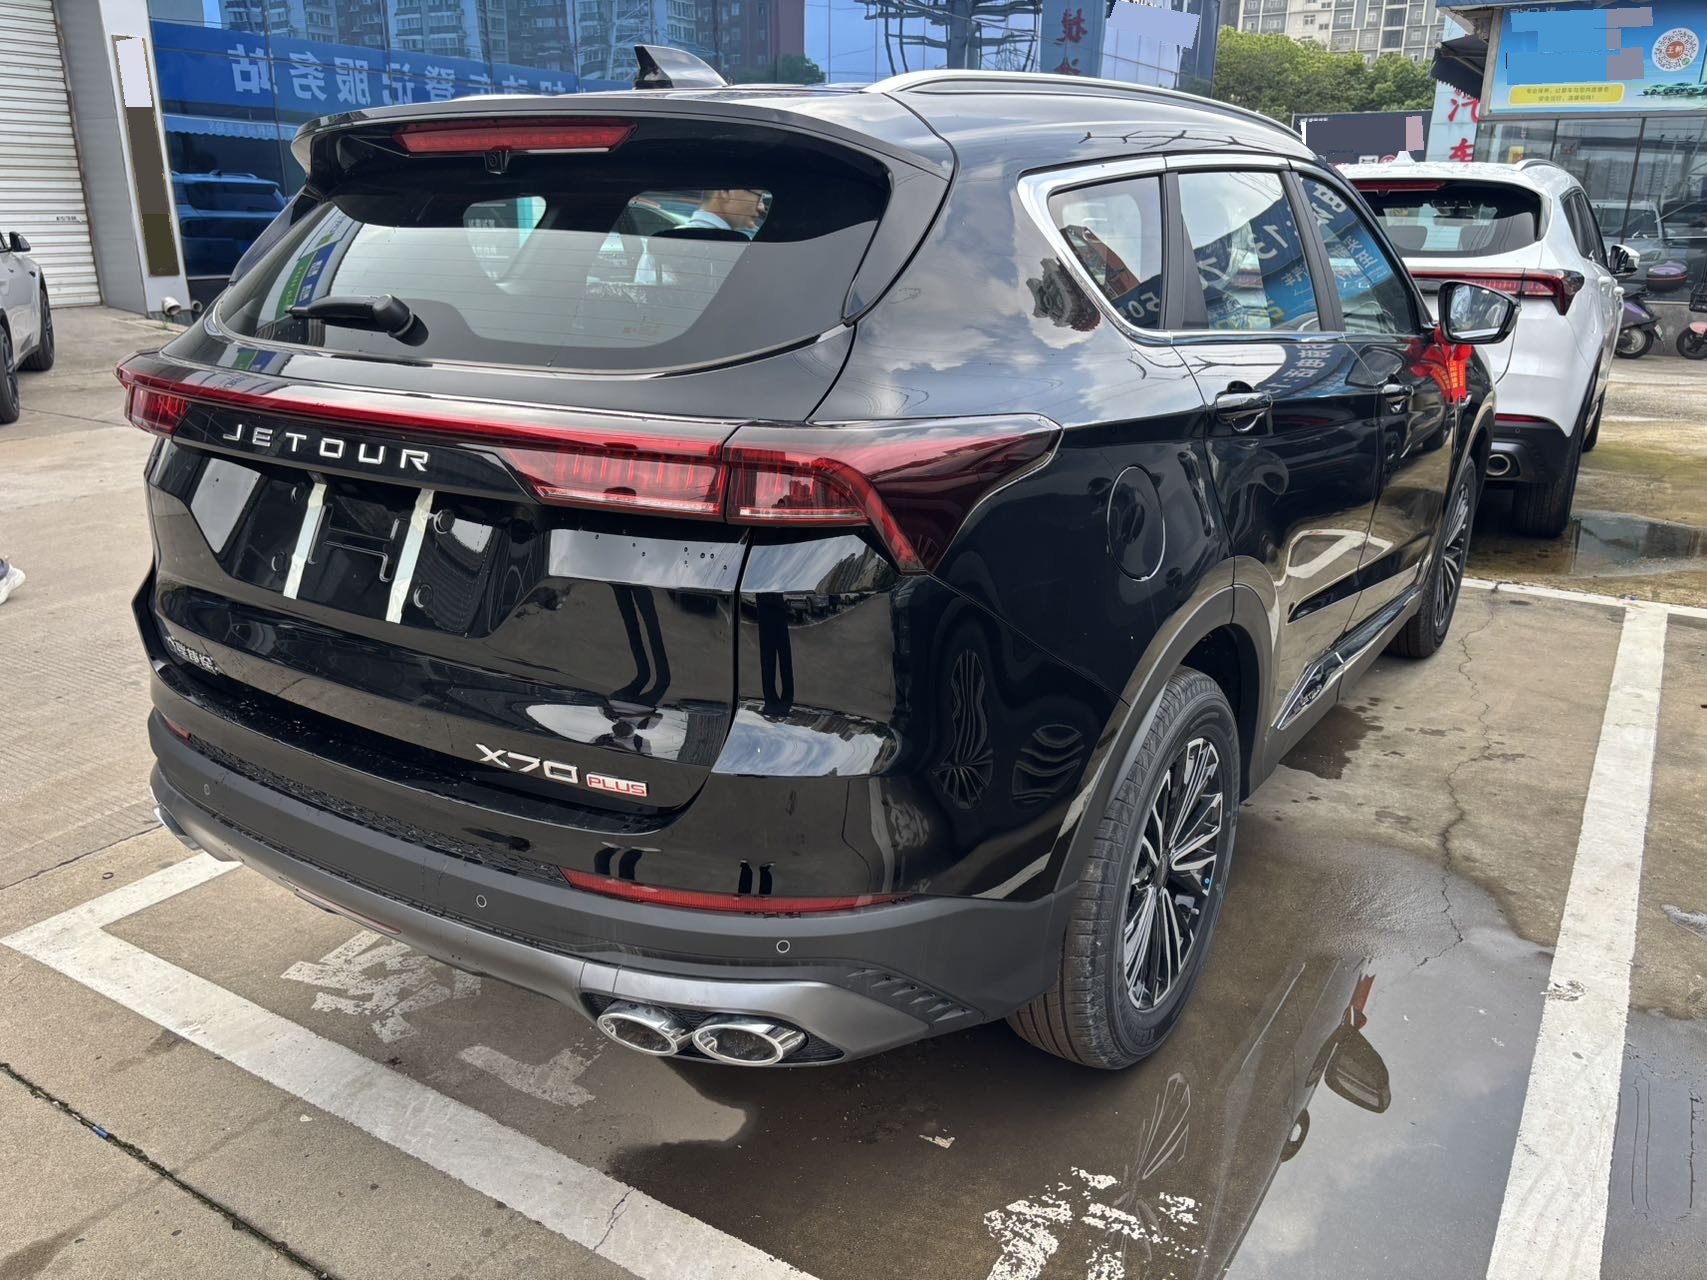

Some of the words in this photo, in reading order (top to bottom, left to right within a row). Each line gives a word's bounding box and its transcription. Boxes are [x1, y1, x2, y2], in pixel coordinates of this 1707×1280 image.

[222, 423, 429, 472] JETOUR
[475, 743, 579, 784] X70
[587, 775, 647, 797] PLUS
